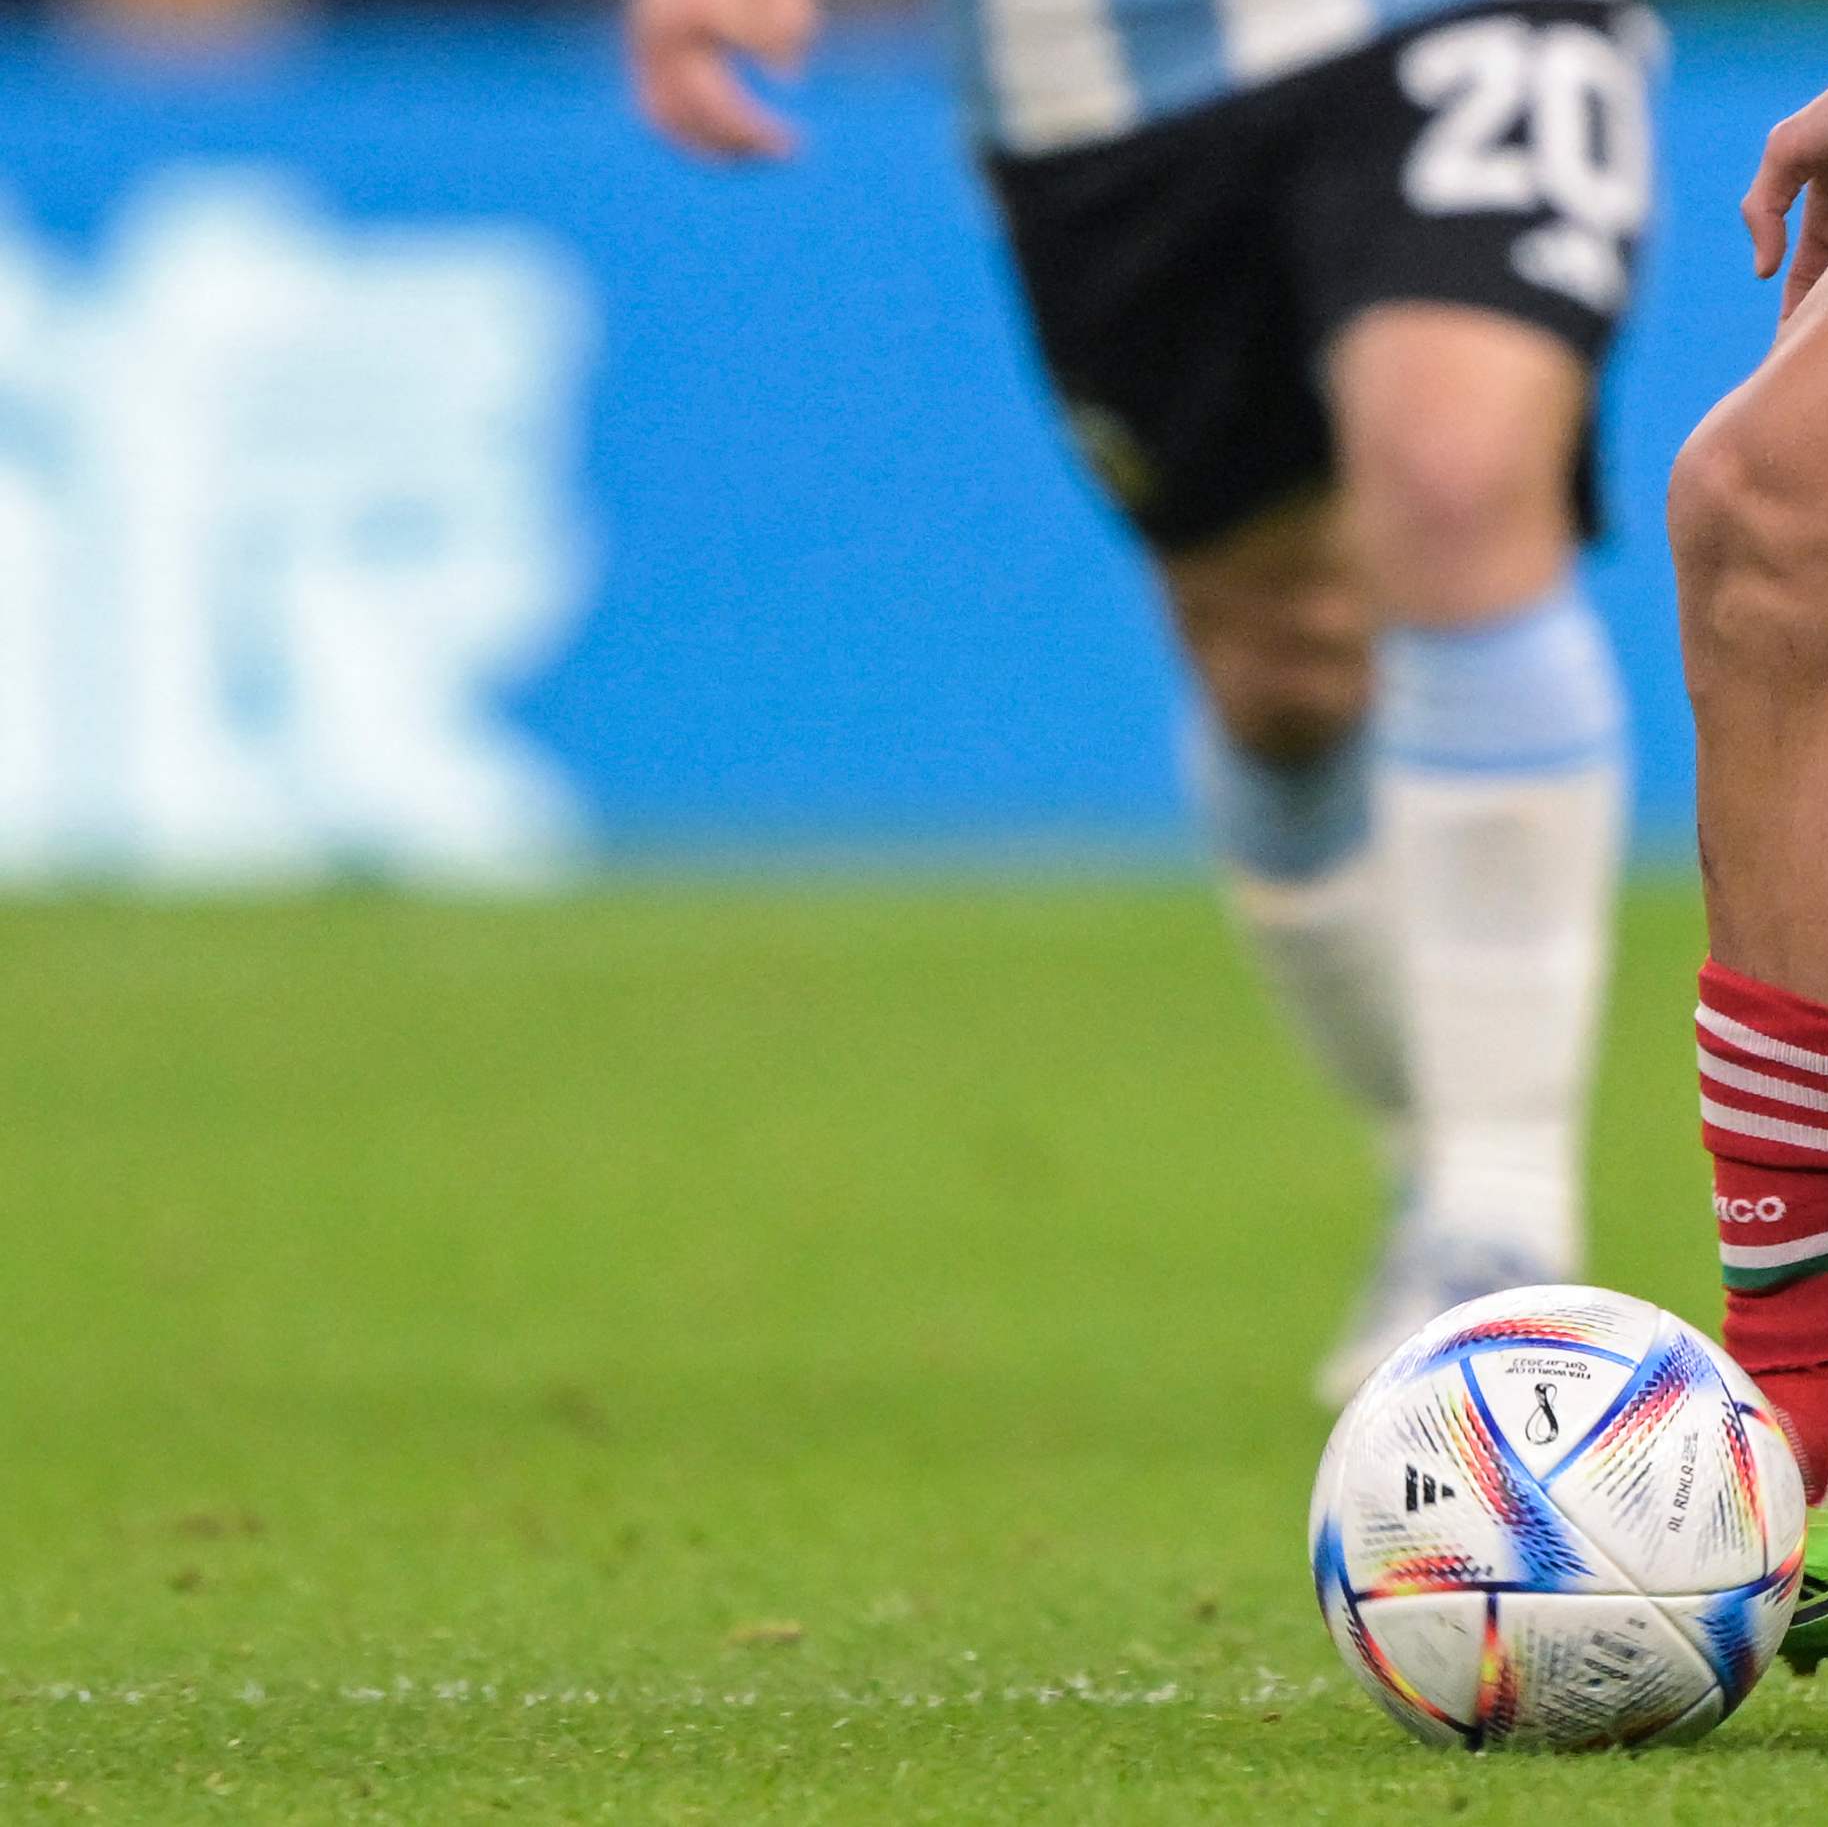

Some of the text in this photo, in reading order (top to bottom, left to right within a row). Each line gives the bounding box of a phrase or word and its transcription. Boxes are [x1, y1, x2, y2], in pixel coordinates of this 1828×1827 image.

[1397, 15, 1654, 228] 20
[1528, 1367, 1567, 1377] WORLD
[1569, 1370, 1591, 1380] FIFA
[1673, 1465, 1694, 1511] RIHLA
[1667, 1515, 1685, 1533] AL
